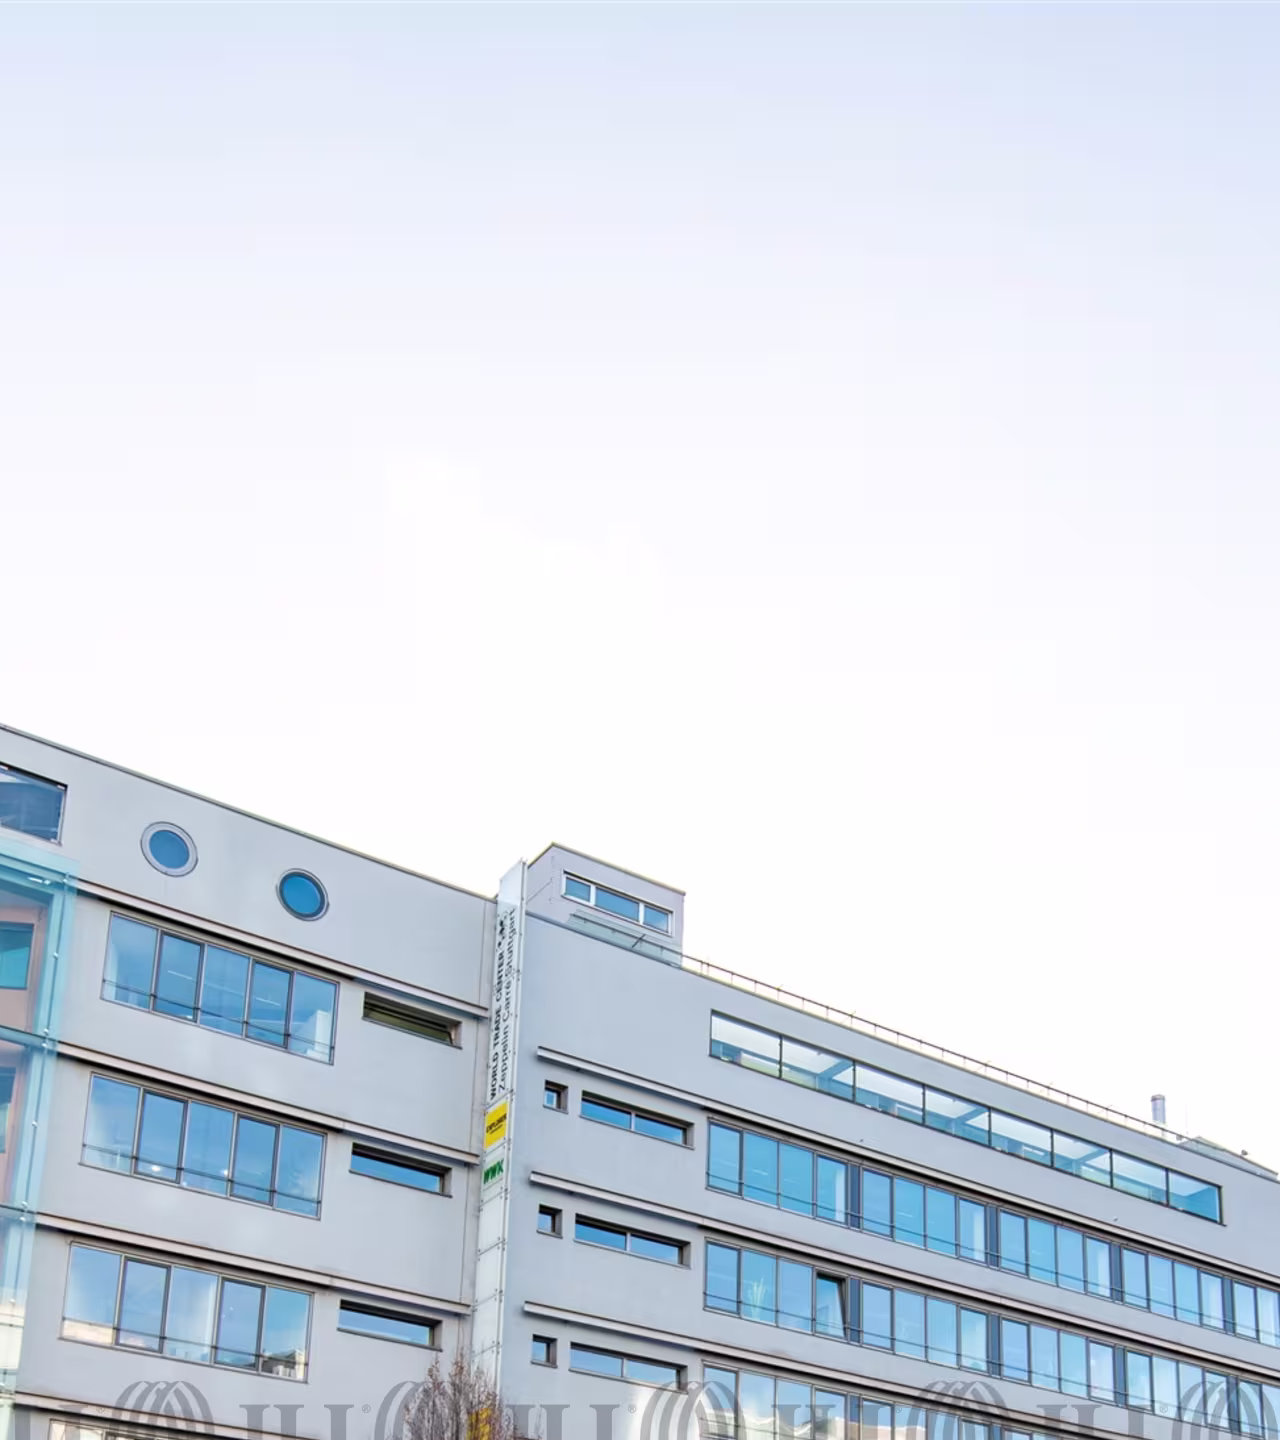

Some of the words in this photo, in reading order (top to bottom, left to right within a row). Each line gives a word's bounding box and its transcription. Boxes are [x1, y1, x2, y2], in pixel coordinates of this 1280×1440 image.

[504, 908, 517, 977] Stuttgart
[495, 951, 505, 1002] CENTER
[502, 979, 512, 1022] Carré
[493, 1008, 502, 1047] TRADE
[489, 1052, 499, 1100] WORLD
[498, 1025, 510, 1091] Zeppelin
